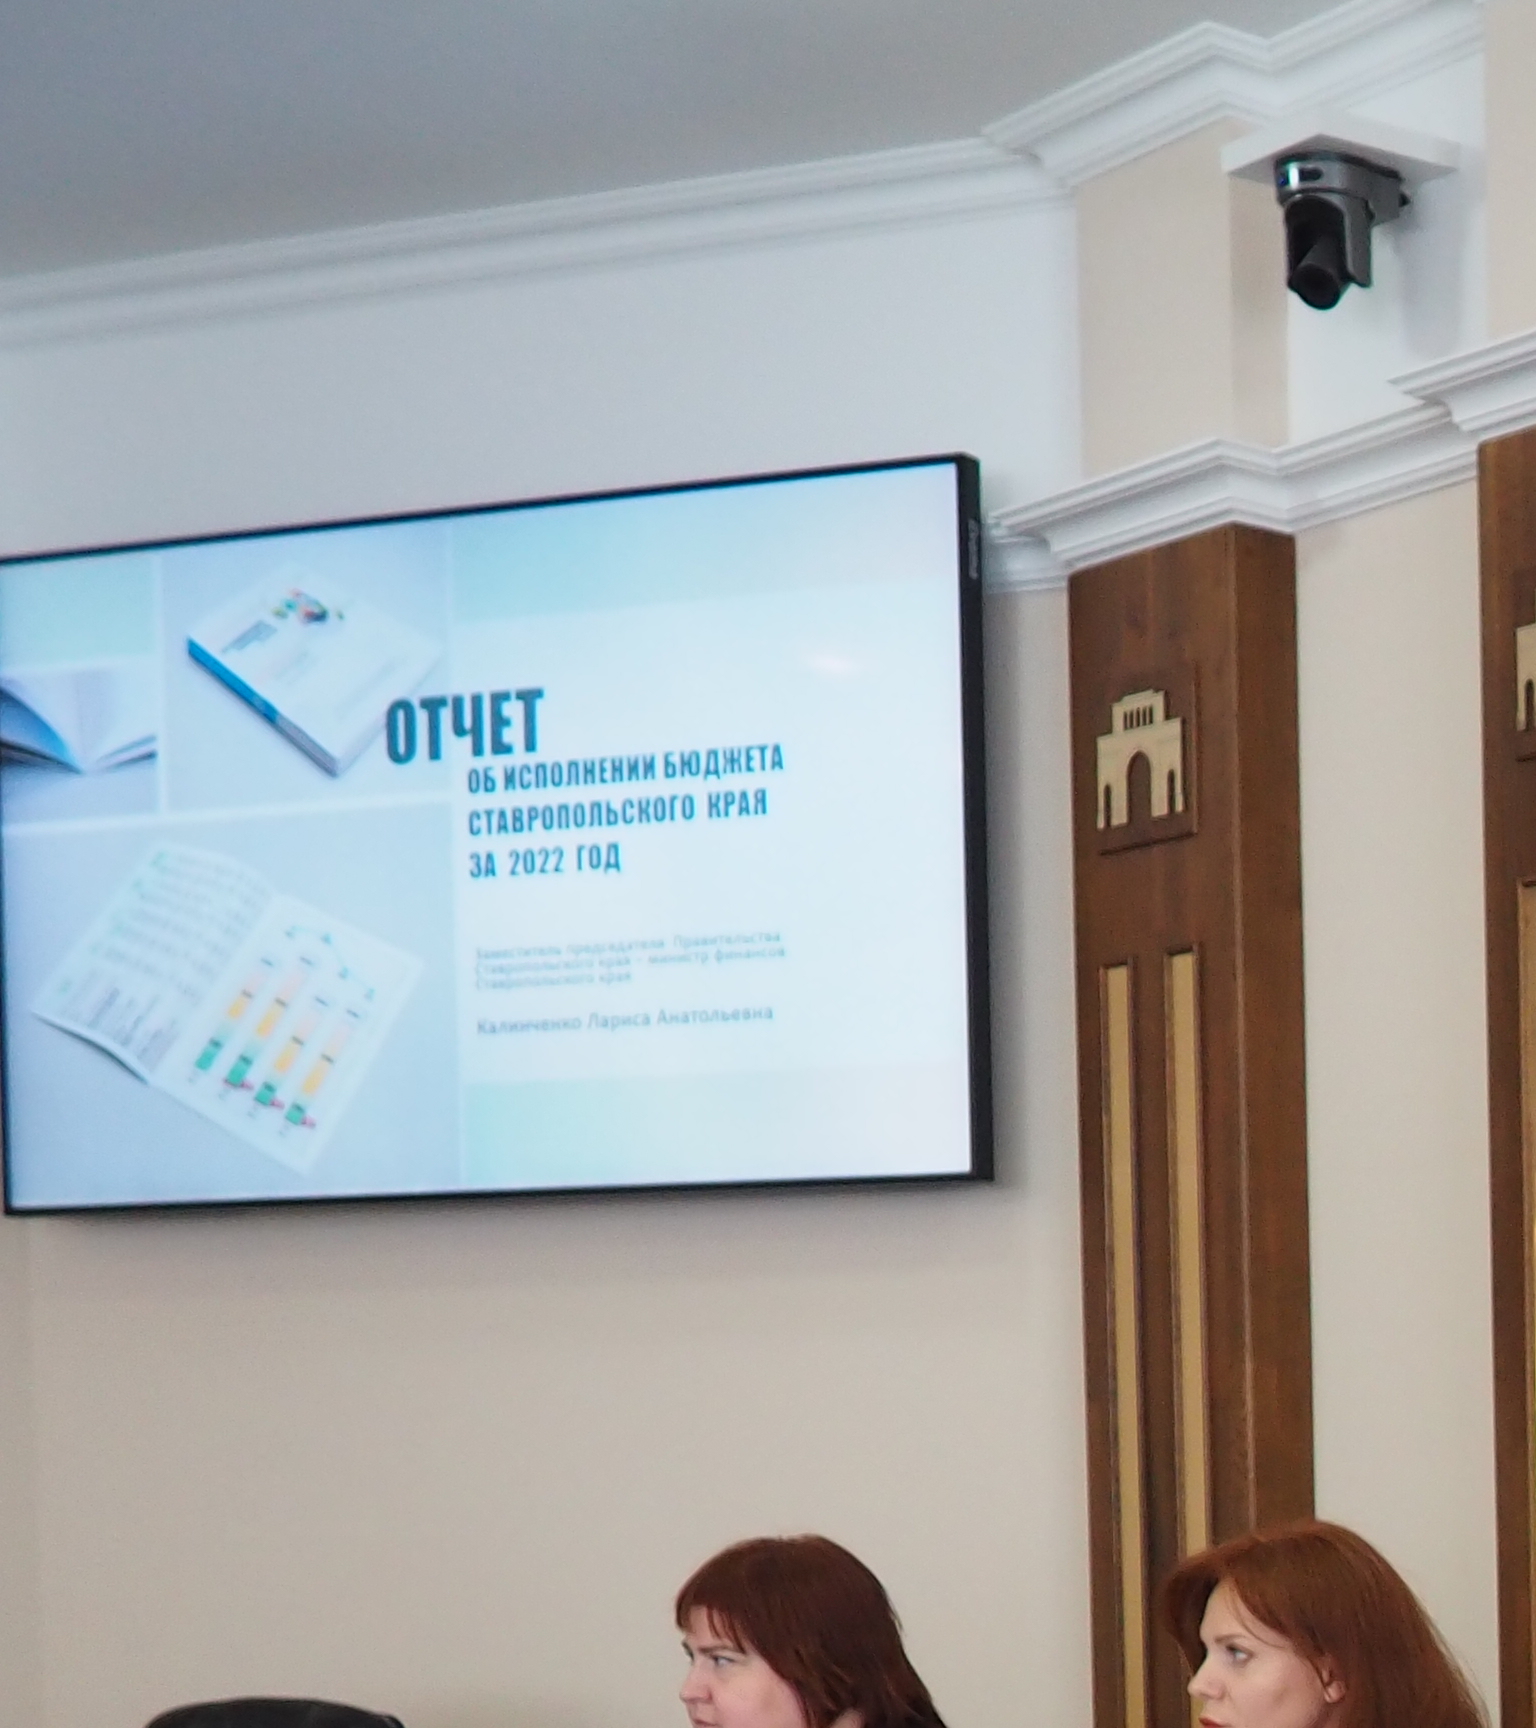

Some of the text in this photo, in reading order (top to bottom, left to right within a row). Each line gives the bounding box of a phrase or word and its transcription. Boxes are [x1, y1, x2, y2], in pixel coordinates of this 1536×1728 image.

[385, 687, 544, 765] ОТЧЕТ
[468, 743, 784, 794] ОБ ИСПОЛНЕНИИ БЮДЖЕТА
[469, 788, 768, 836] СТАВРОПОЛЬСКОГО КРАЯ
[470, 842, 621, 878] ЗА 2022 ГОД
[476, 1006, 774, 1035] Калинченко Лариса Анатольевна
